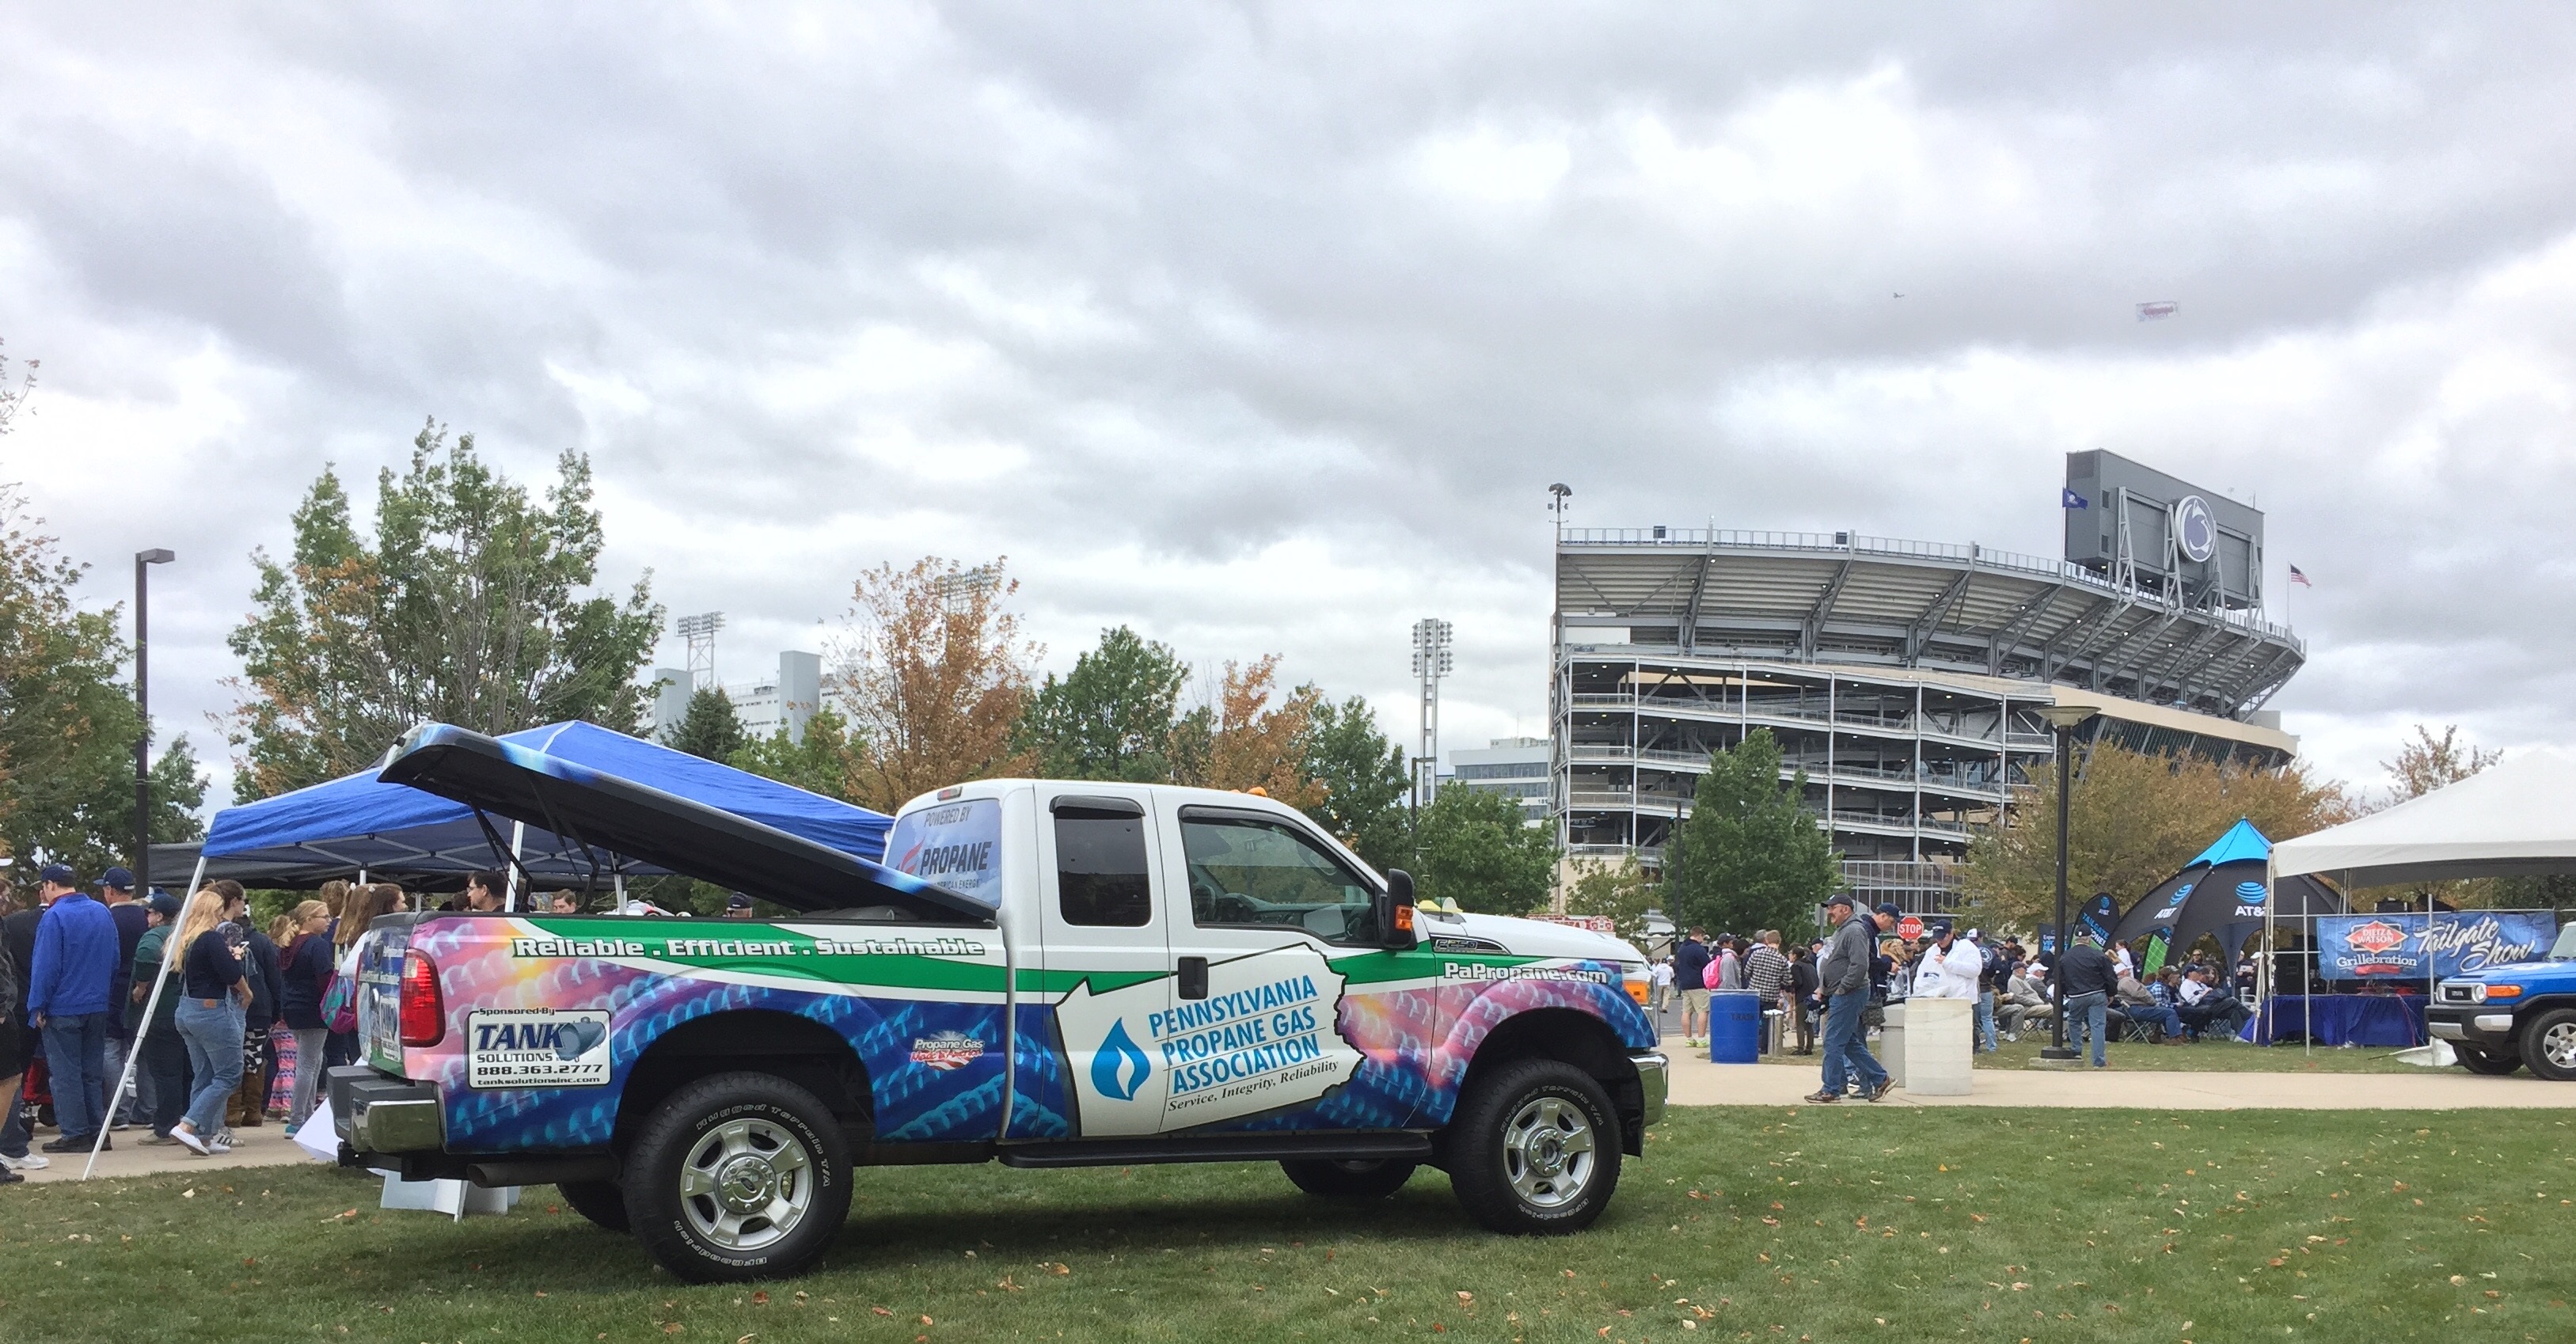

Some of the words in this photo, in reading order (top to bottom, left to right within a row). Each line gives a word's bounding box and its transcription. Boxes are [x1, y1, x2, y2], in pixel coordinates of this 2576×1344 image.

[923, 808, 958, 828] POWERED
[959, 805, 973, 822] BY
[919, 841, 993, 876] PROPANE
[2234, 905, 2272, 917] AT&
[1899, 924, 1922, 934] STOP
[2082, 912, 2111, 940] TAILGATE
[2414, 916, 2500, 958] Tailgate
[511, 938, 645, 958] Reliable
[665, 938, 797, 957] Efficient
[813, 938, 986, 956] Sustainable
[2460, 936, 2536, 973] Show
[2336, 953, 2418, 966] Grillebration
[1443, 962, 1608, 984] PaPropane.com
[479, 1008, 539, 1016] Sponsored
[1149, 974, 1318, 1038] PENNSYLVANIA
[474, 1022, 568, 1051] TANK
[914, 1038, 960, 1051] Propane
[962, 1038, 984, 1049] Gas
[1161, 1017, 1267, 1065] PROPANE
[1272, 1005, 1316, 1037] GAS
[477, 1053, 553, 1063] SOLUTIONS
[1173, 1033, 1320, 1095] ASSOCIATION
[477, 1064, 603, 1076] 888.363.2777
[477, 1076, 601, 1086] tanksolutionsinc.com
[1168, 1093, 1218, 1112] Service,
[1222, 1077, 1277, 1099] Integrity,
[1280, 1061, 1339, 1084] Reliability
